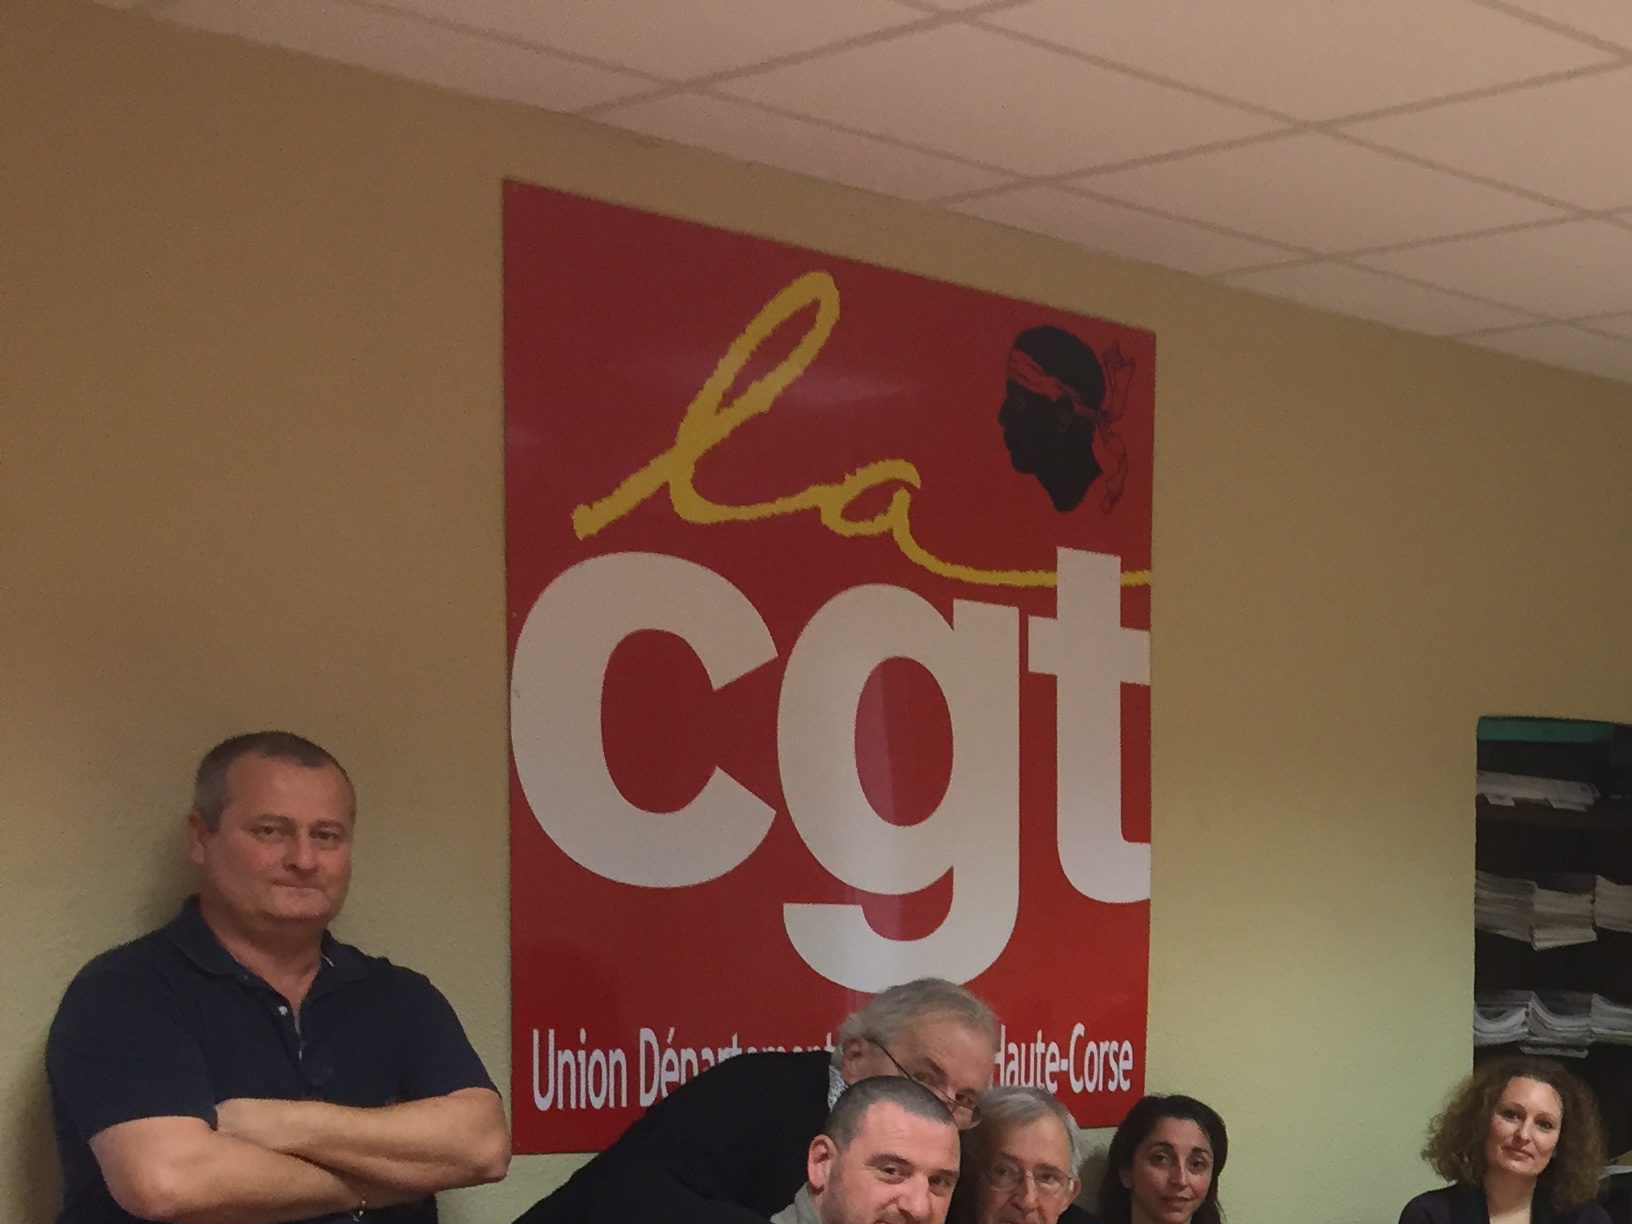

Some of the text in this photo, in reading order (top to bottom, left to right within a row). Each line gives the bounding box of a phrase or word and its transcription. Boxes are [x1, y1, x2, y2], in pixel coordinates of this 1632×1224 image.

[572, 271, 1058, 588] la
[510, 546, 1152, 994] cgt
[532, 1026, 628, 1112] Union
